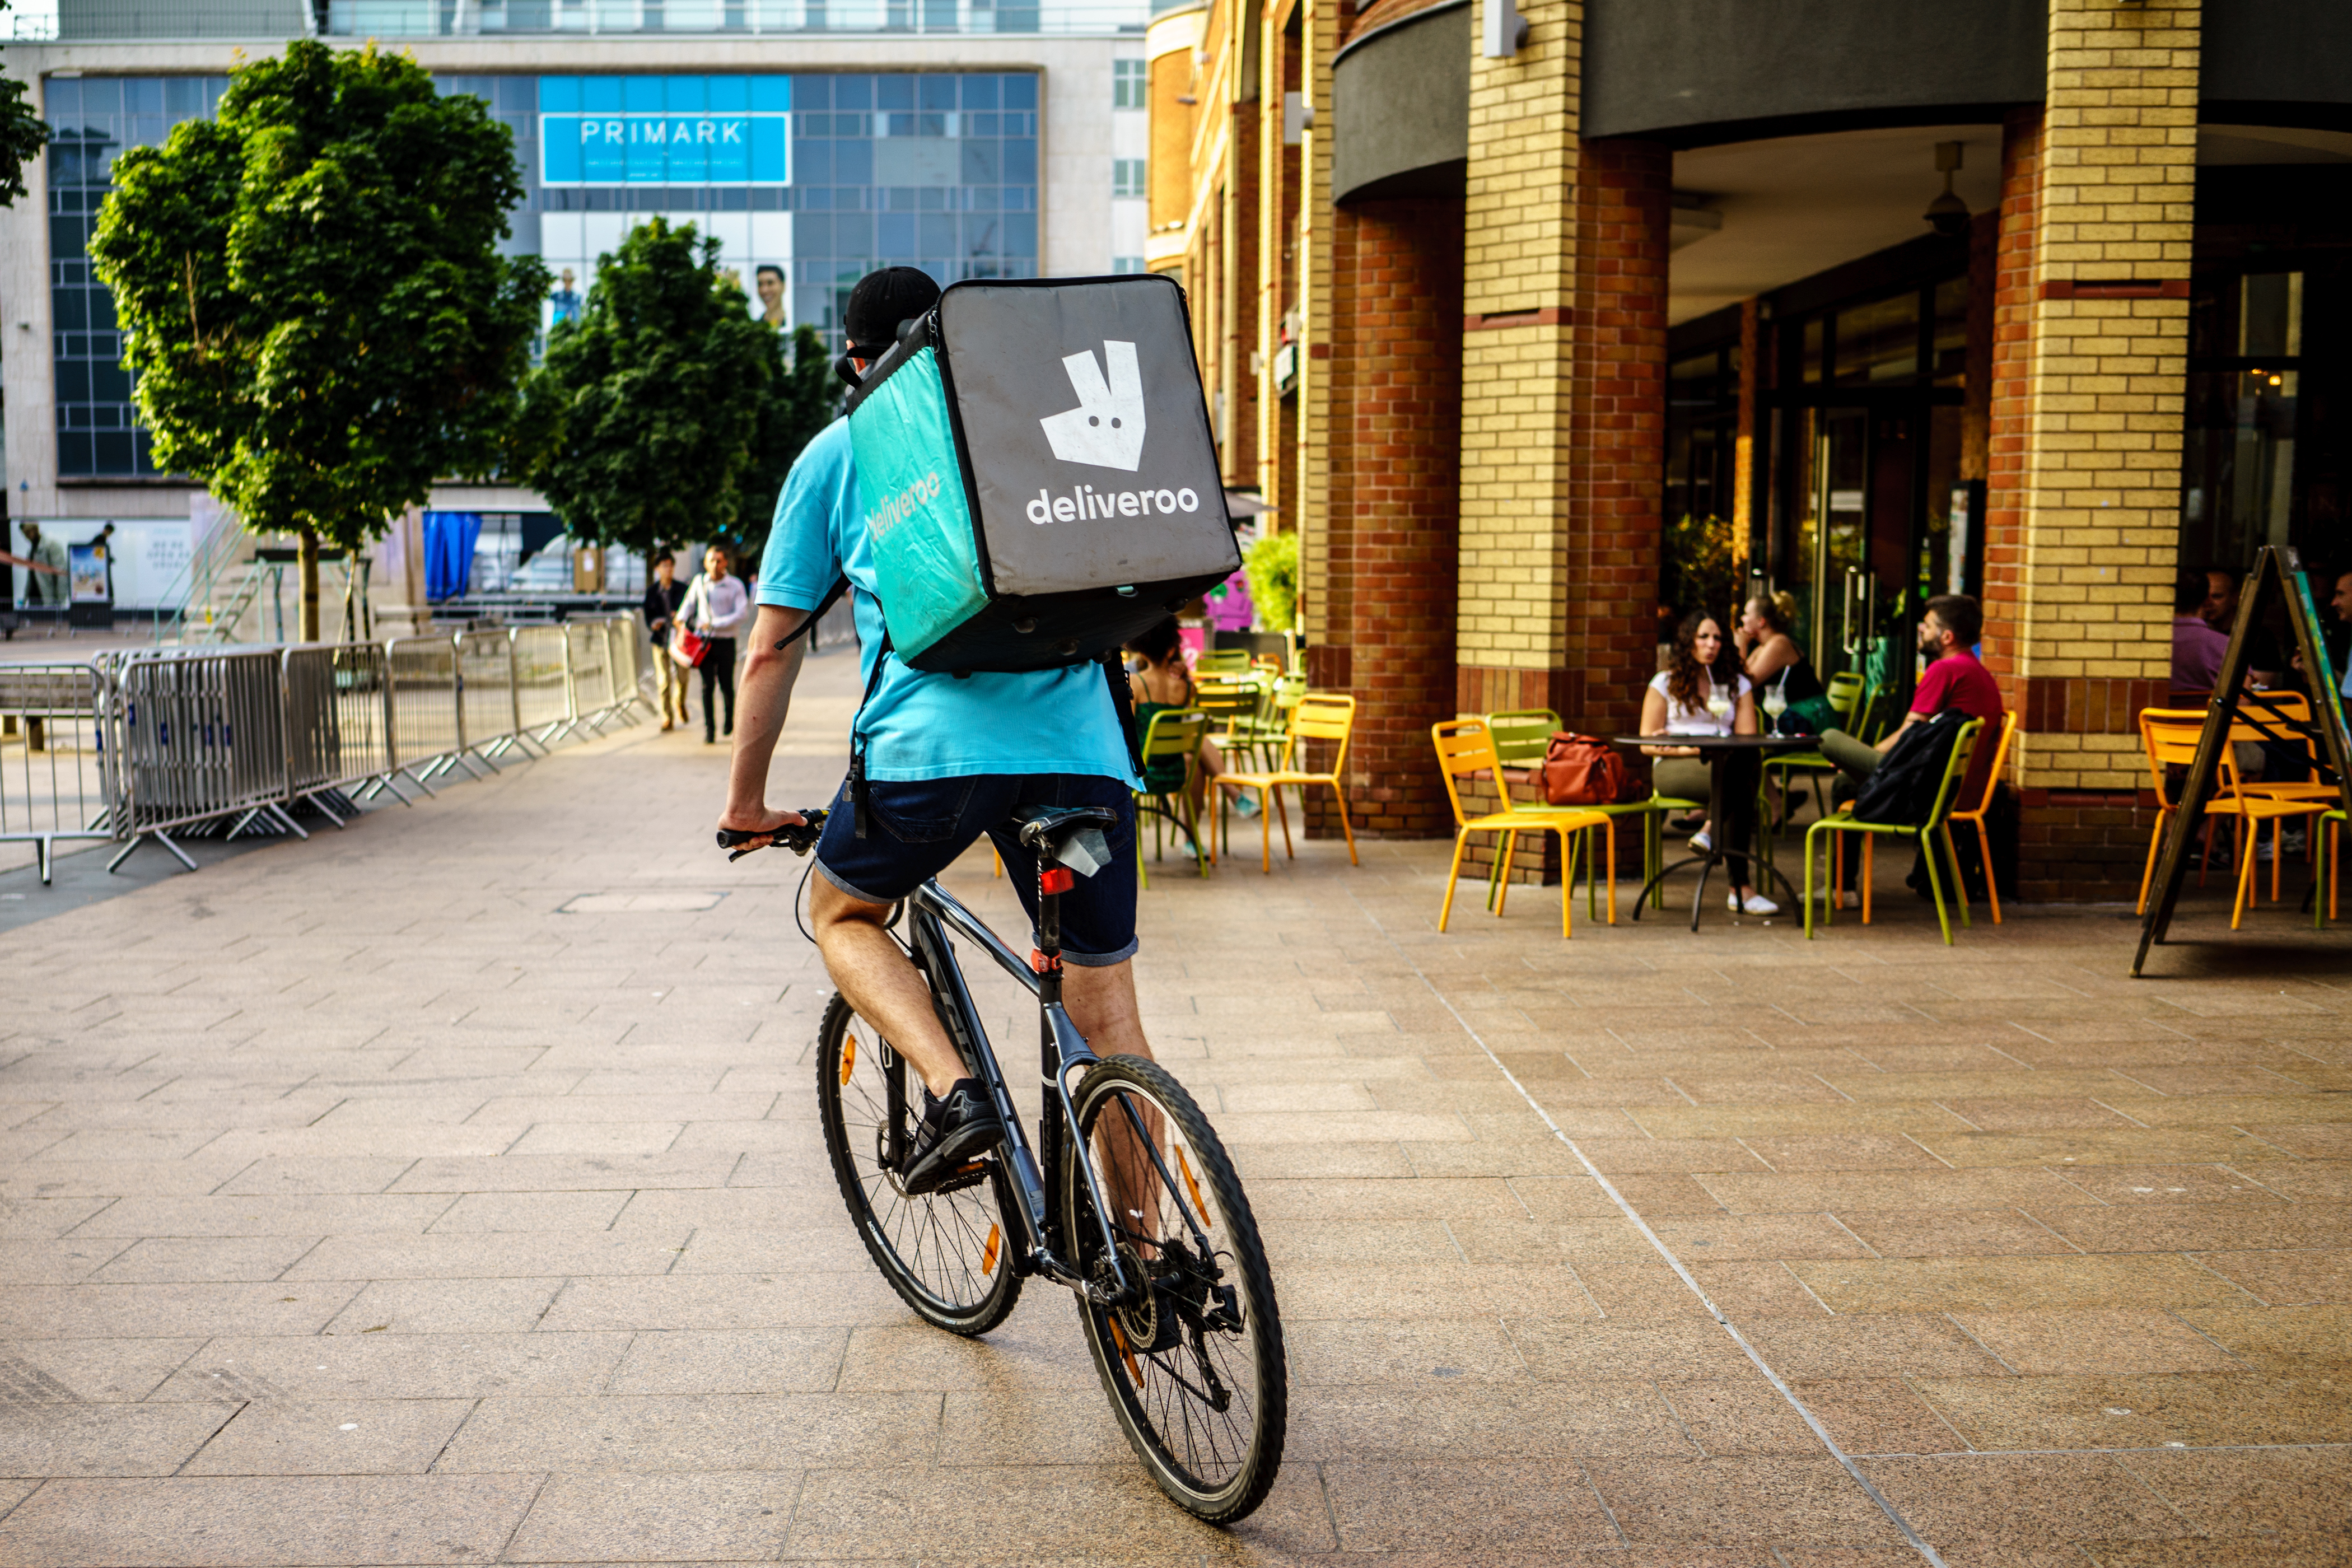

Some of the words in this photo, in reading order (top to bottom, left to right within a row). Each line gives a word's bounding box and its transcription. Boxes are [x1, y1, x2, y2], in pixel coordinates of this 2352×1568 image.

[580, 120, 742, 146] PRIMARK
[869, 472, 940, 543] deliveroo
[1026, 484, 1199, 525] deliveroo
